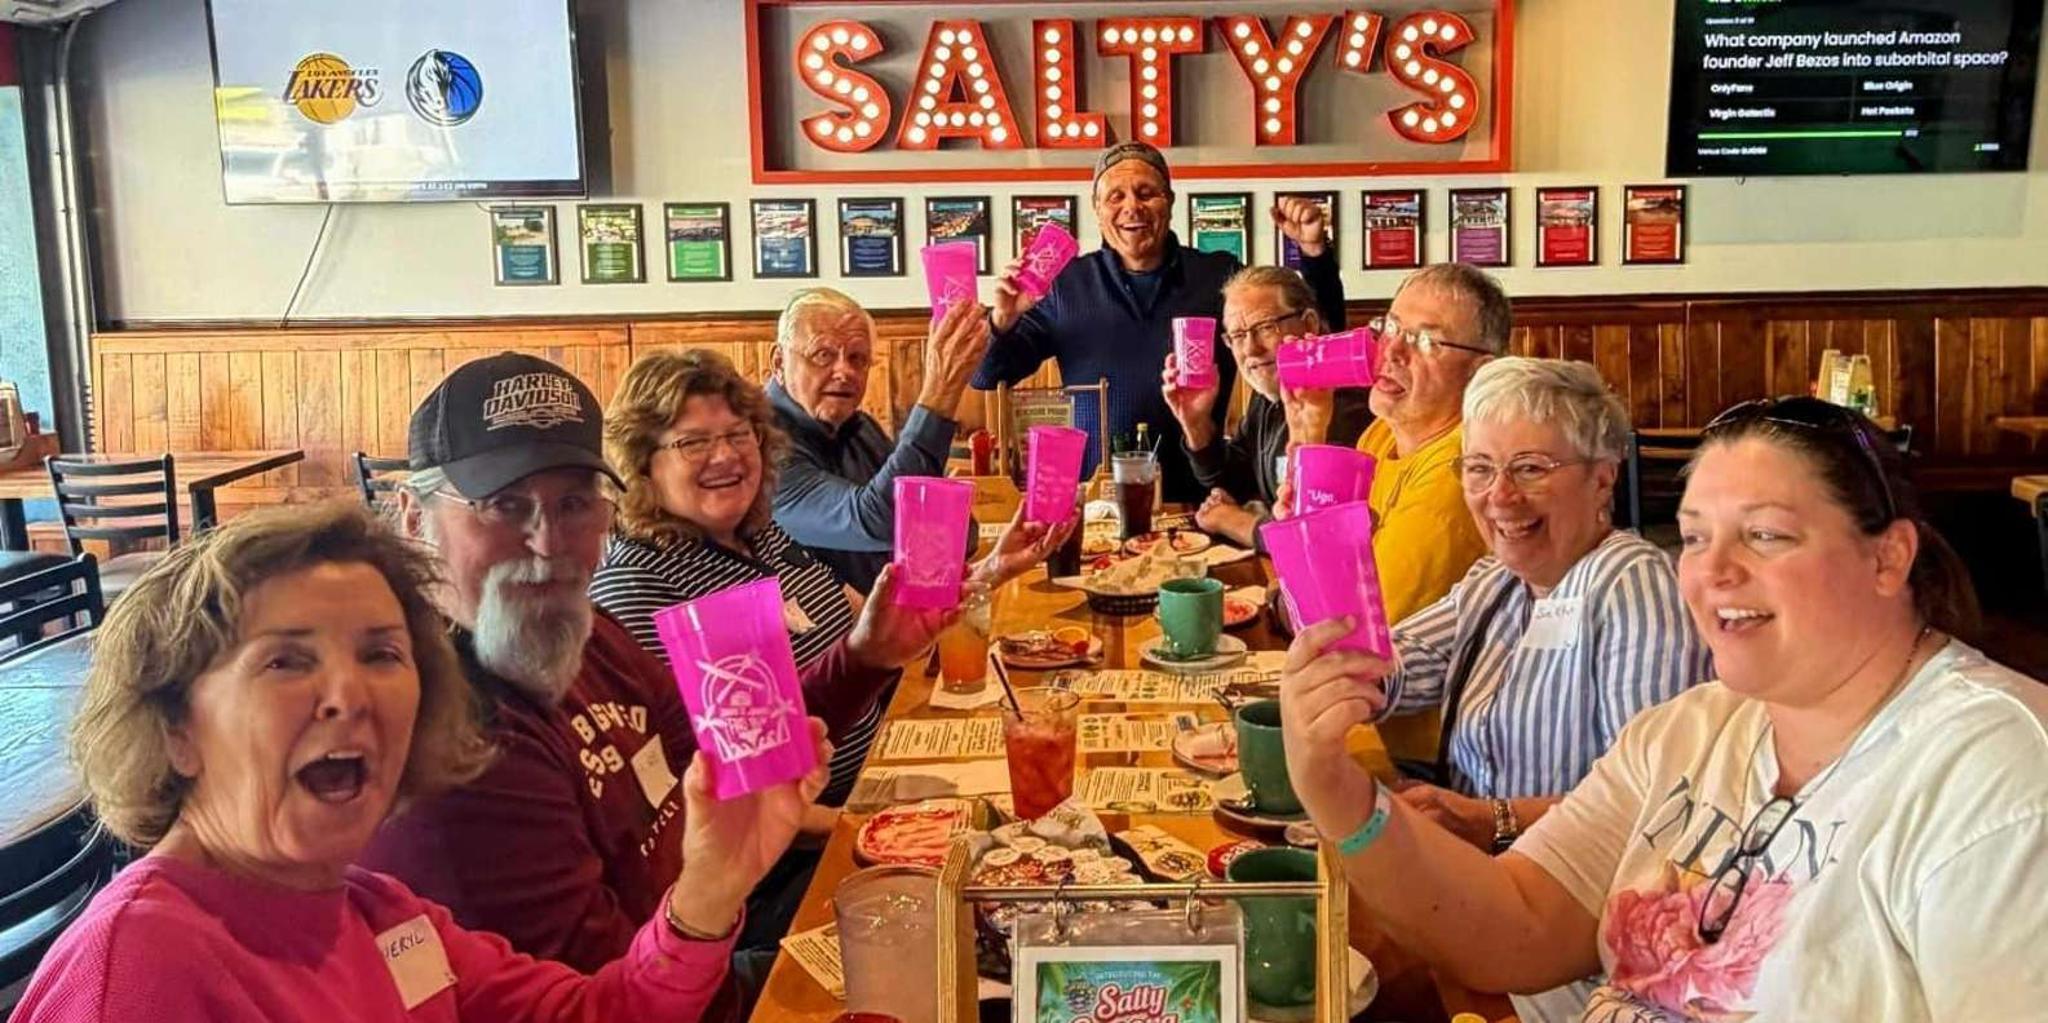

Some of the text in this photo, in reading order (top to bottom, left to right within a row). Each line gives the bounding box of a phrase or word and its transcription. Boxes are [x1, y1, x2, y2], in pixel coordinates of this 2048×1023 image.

[1704, 31, 1961, 50] What company launched Amazon
[1703, 51, 2009, 69] founder Jeff Bezos into suborbital space?
[283, 70, 384, 108] LAKERS
[797, 9, 1480, 153] SALTY'S
[1863, 80, 1914, 92] Blue Origin
[1709, 108, 1737, 120] Virgin
[483, 388, 582, 420] DAVIDSON
[1096, 982, 1167, 1020] Salty
